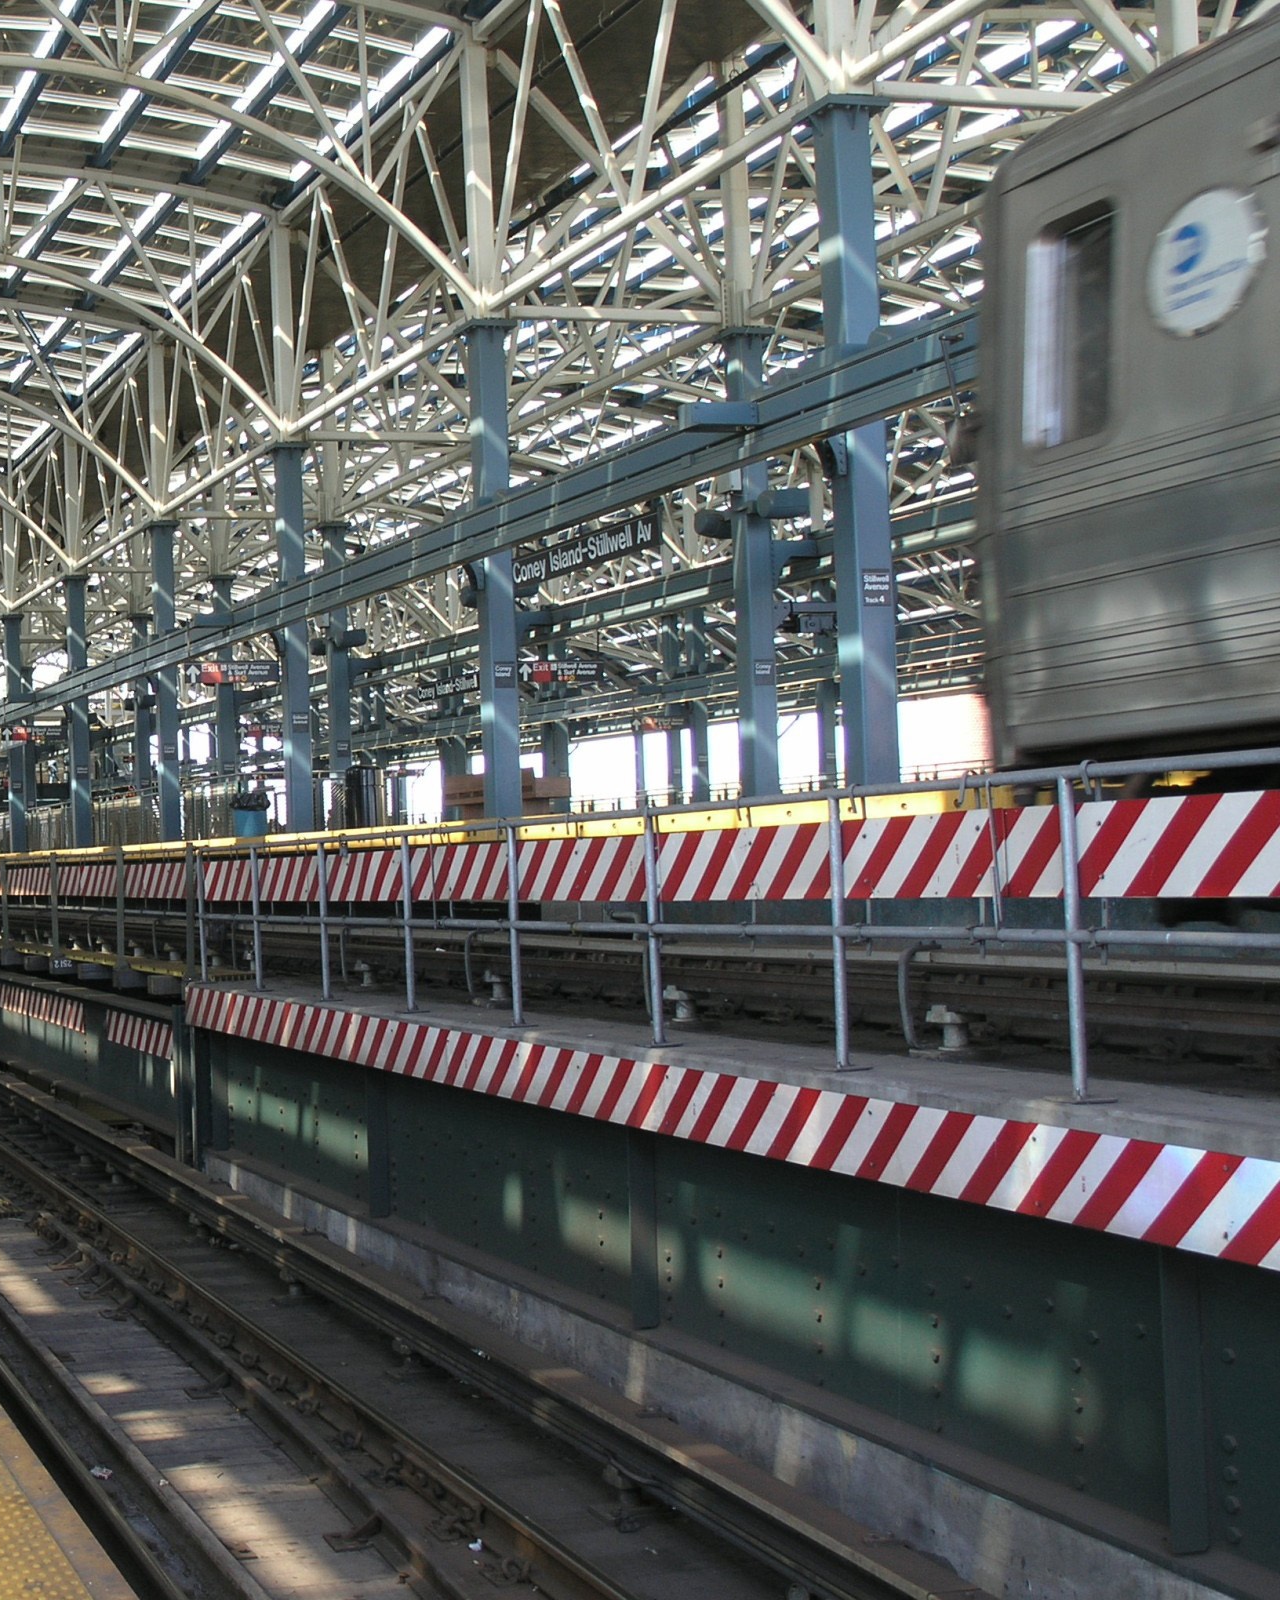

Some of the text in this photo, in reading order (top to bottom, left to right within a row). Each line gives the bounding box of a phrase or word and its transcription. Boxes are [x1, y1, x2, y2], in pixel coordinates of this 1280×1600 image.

[513, 520, 652, 584] Coney Island-Stillwell Av
[202, 664, 219, 672] Exit
[533, 663, 549, 671] Exit
